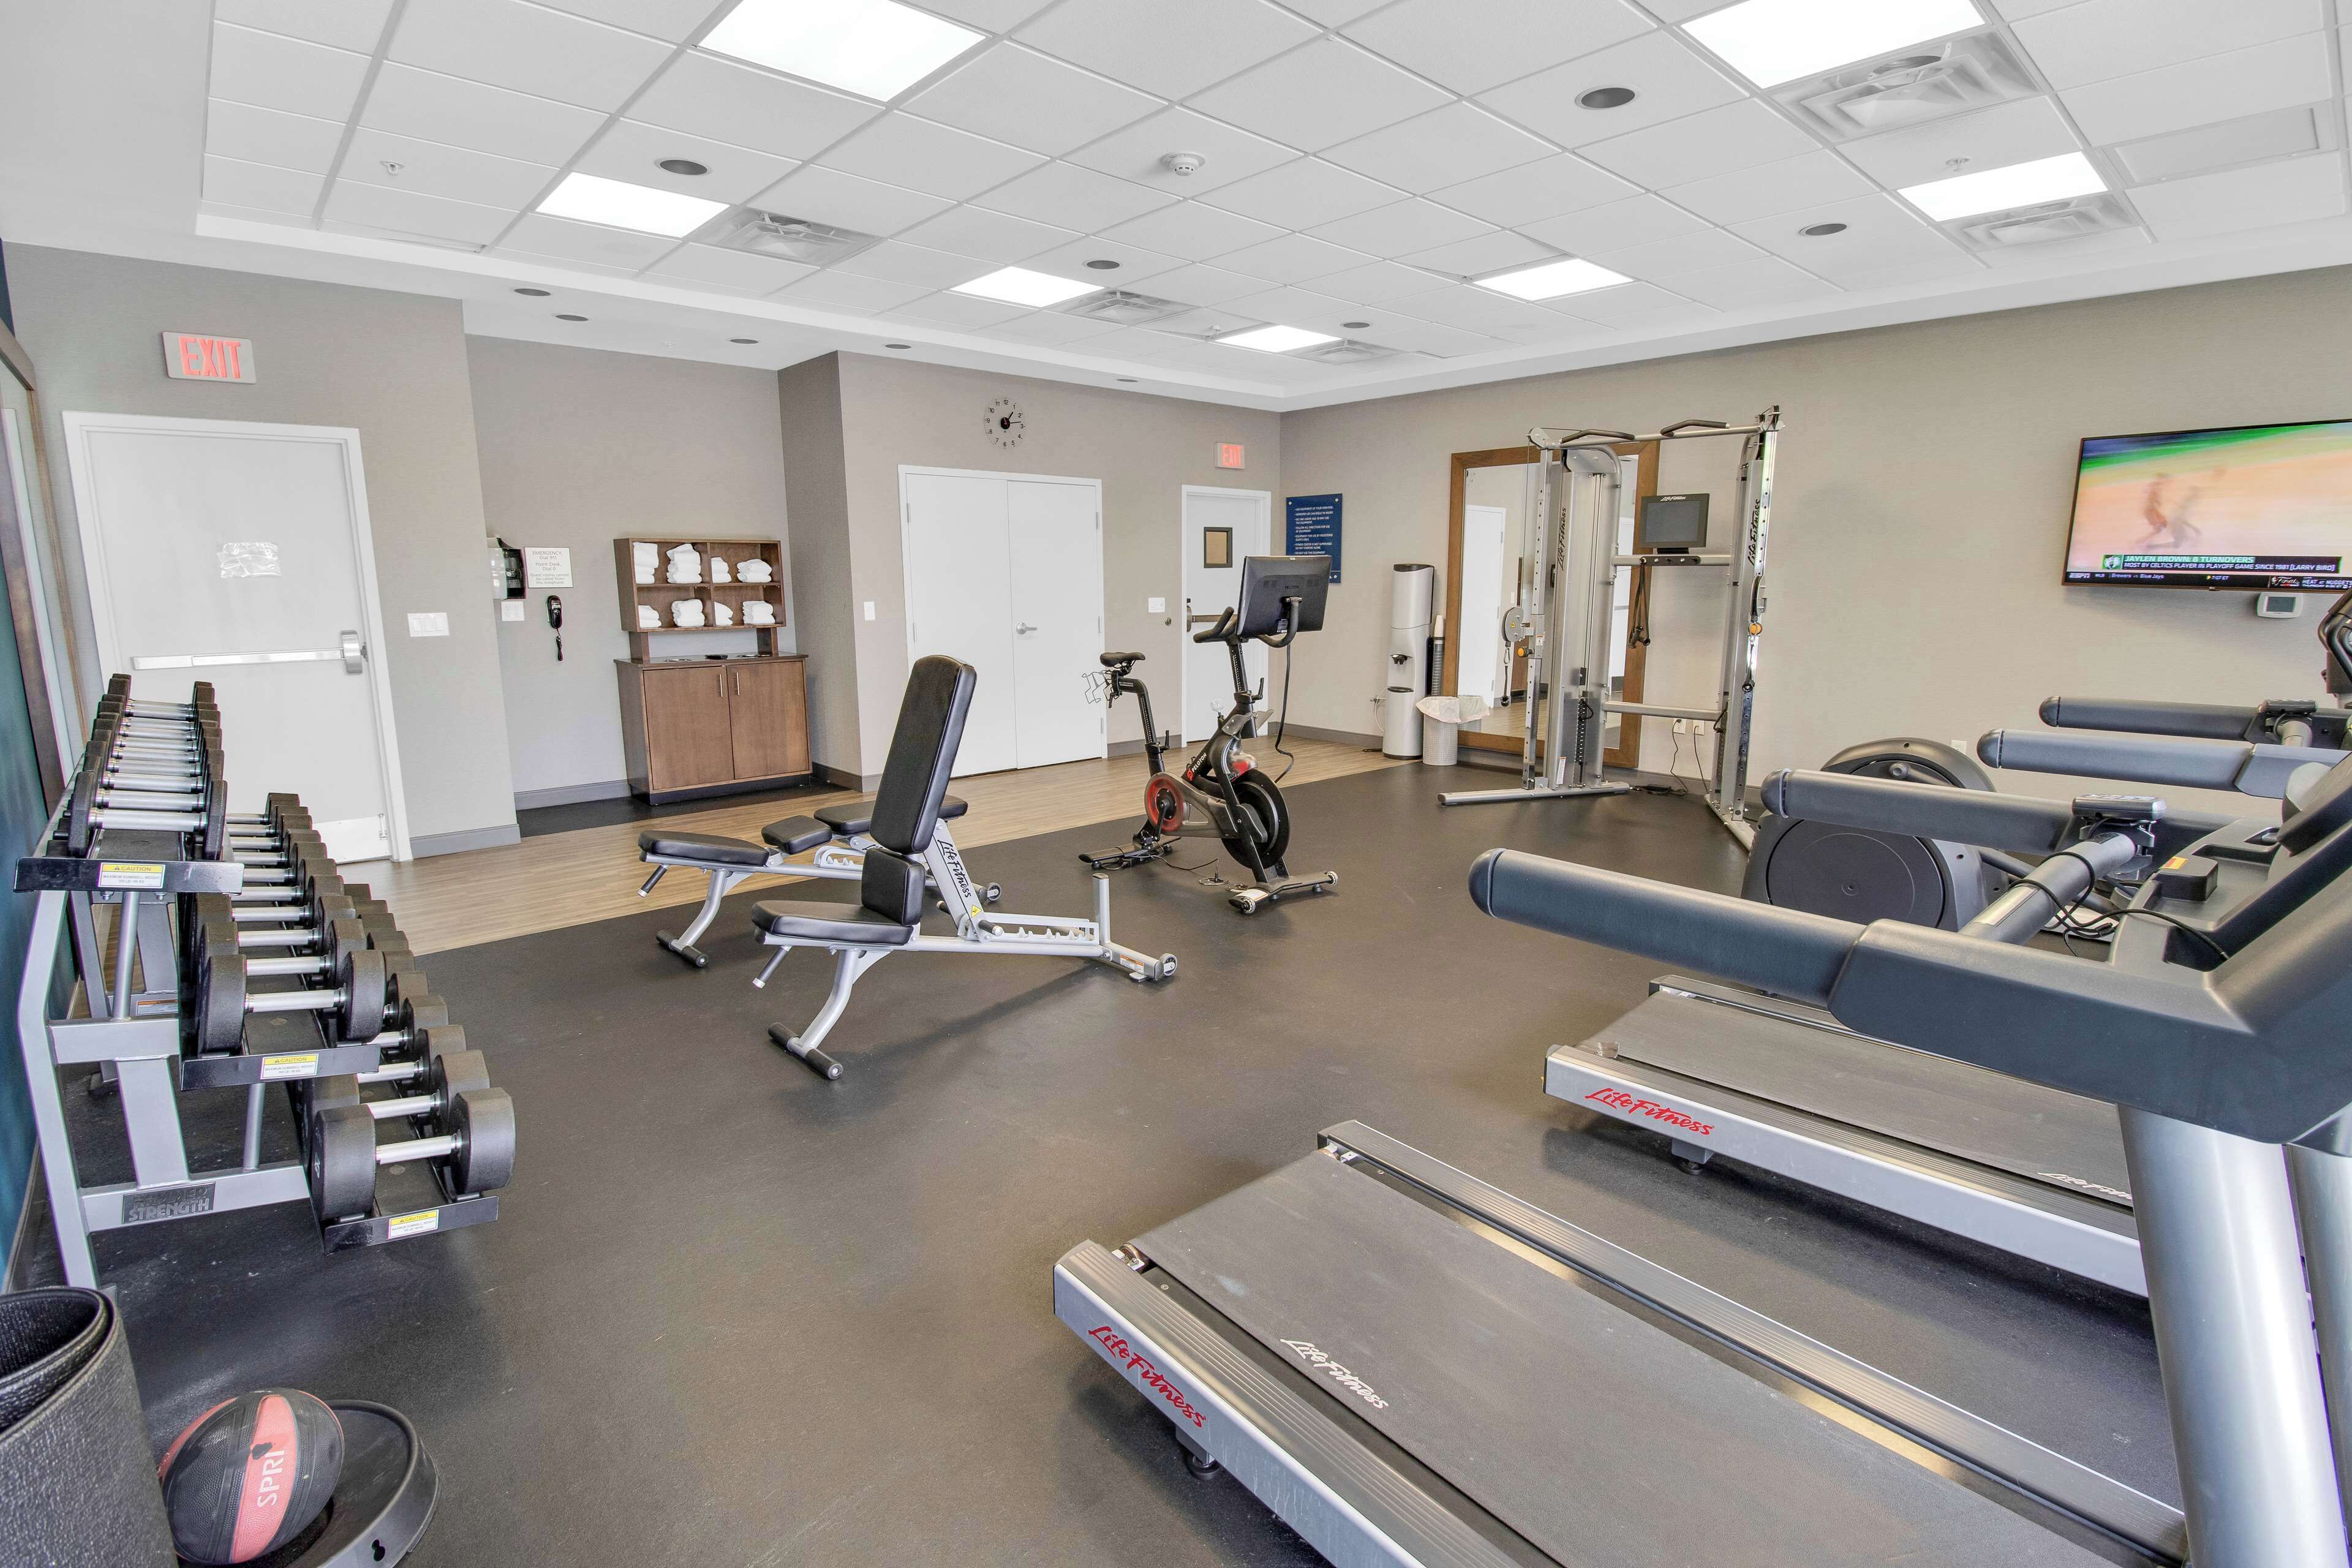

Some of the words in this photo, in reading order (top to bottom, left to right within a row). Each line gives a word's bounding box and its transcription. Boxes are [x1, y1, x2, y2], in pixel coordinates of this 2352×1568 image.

[179, 336, 241, 379] EXIT
[1223, 445, 1242, 466] EXIT
[1191, 752, 1207, 773] PELOTON
[129, 1198, 209, 1222] STRENGTH
[258, 1450, 285, 1507] SPRI
